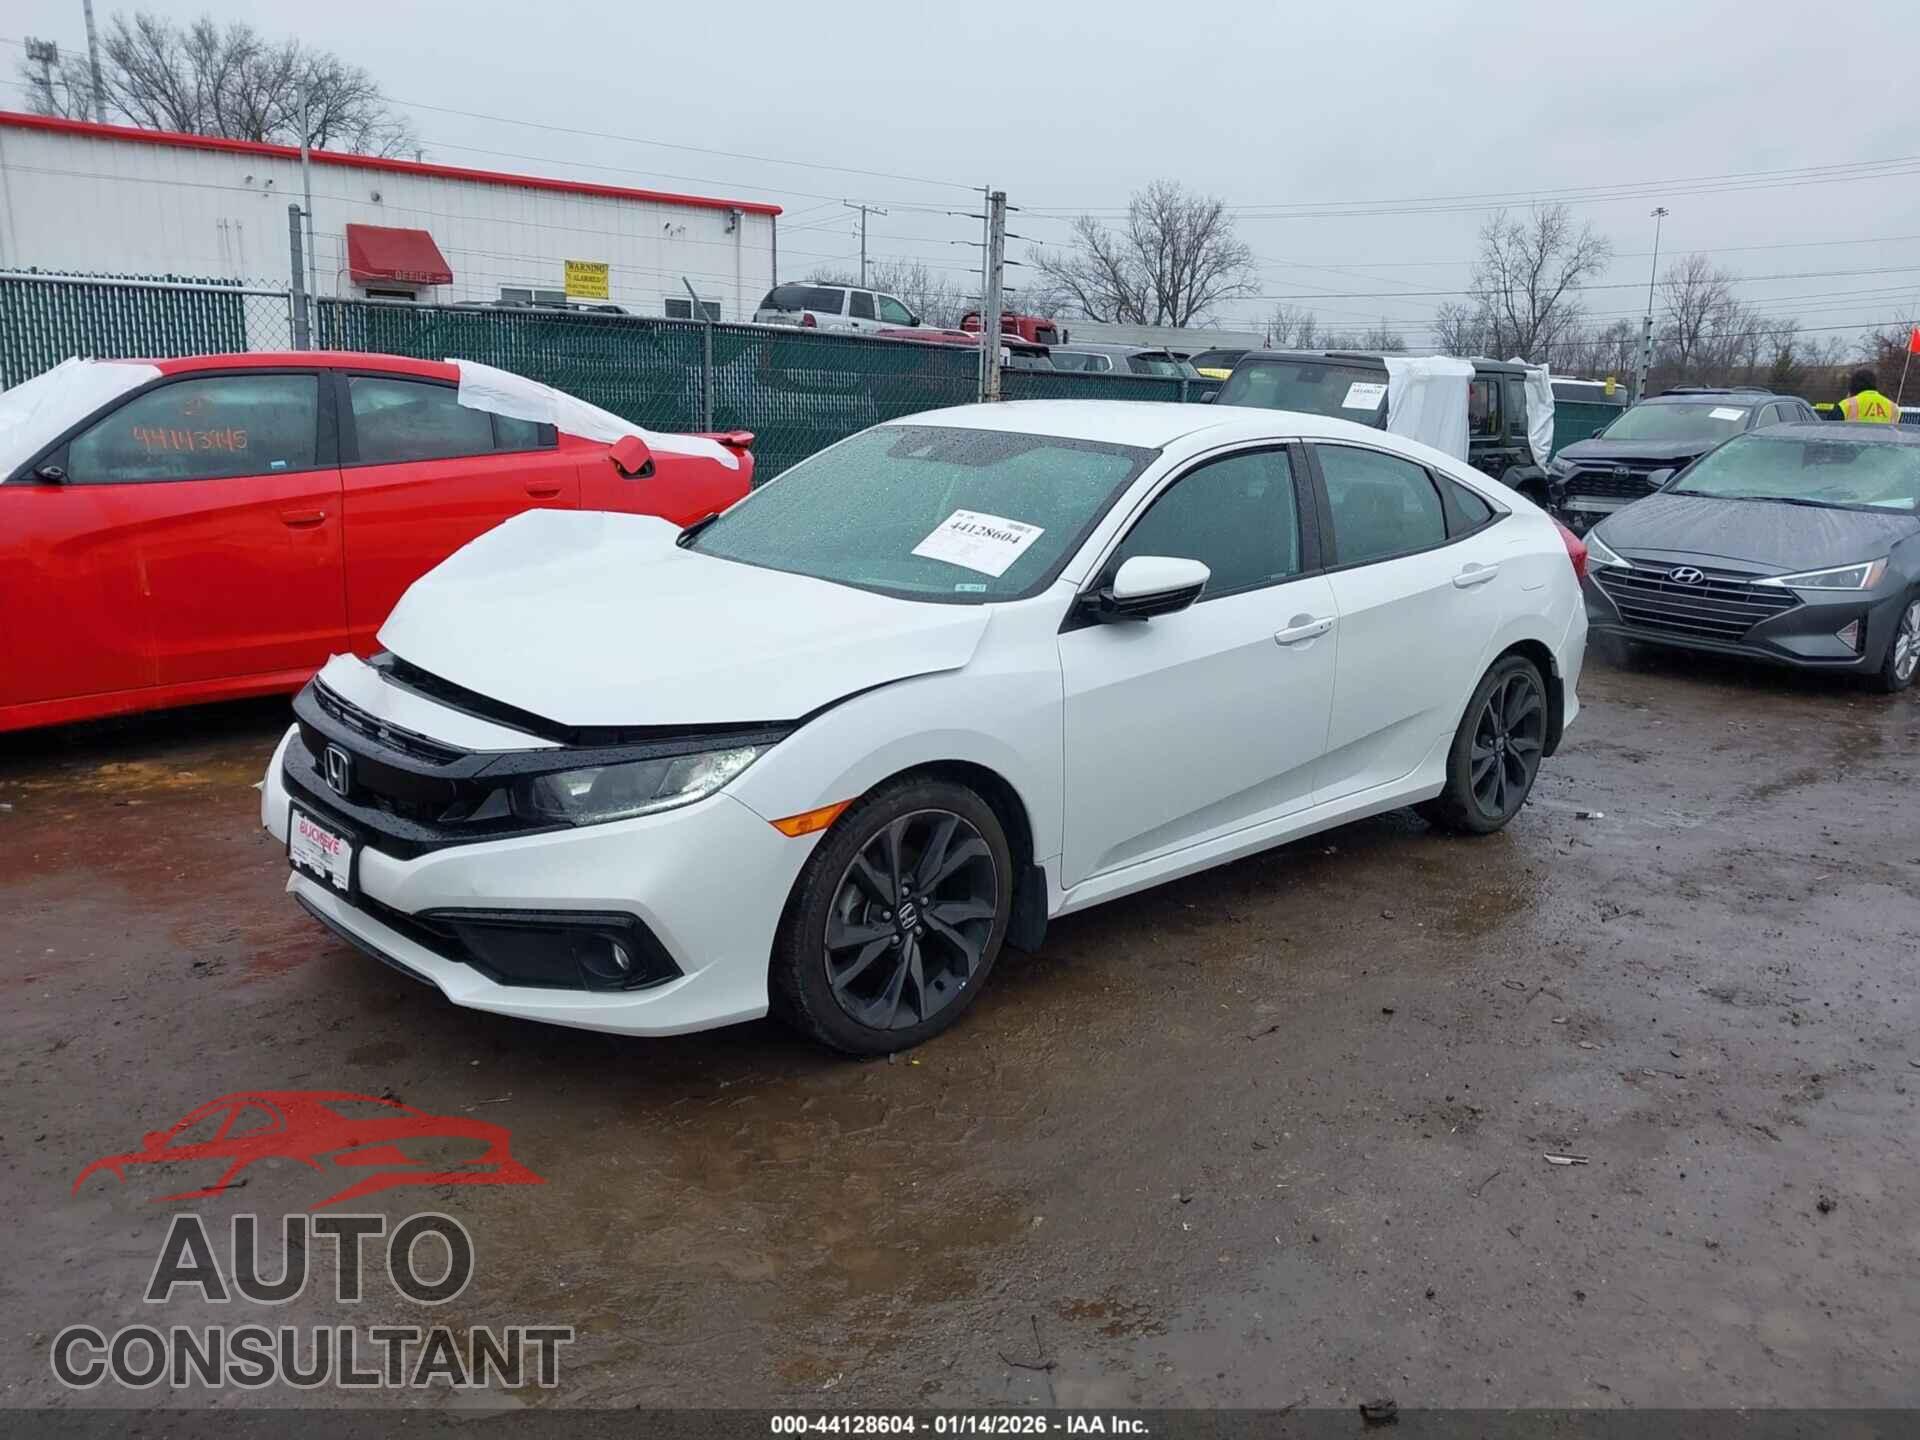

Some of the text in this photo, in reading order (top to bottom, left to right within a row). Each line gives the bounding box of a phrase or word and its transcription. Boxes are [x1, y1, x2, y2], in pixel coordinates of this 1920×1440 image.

[567, 262, 607, 273] WARNING
[394, 271, 433, 283] OFFICE
[950, 521, 1022, 544] 44128604
